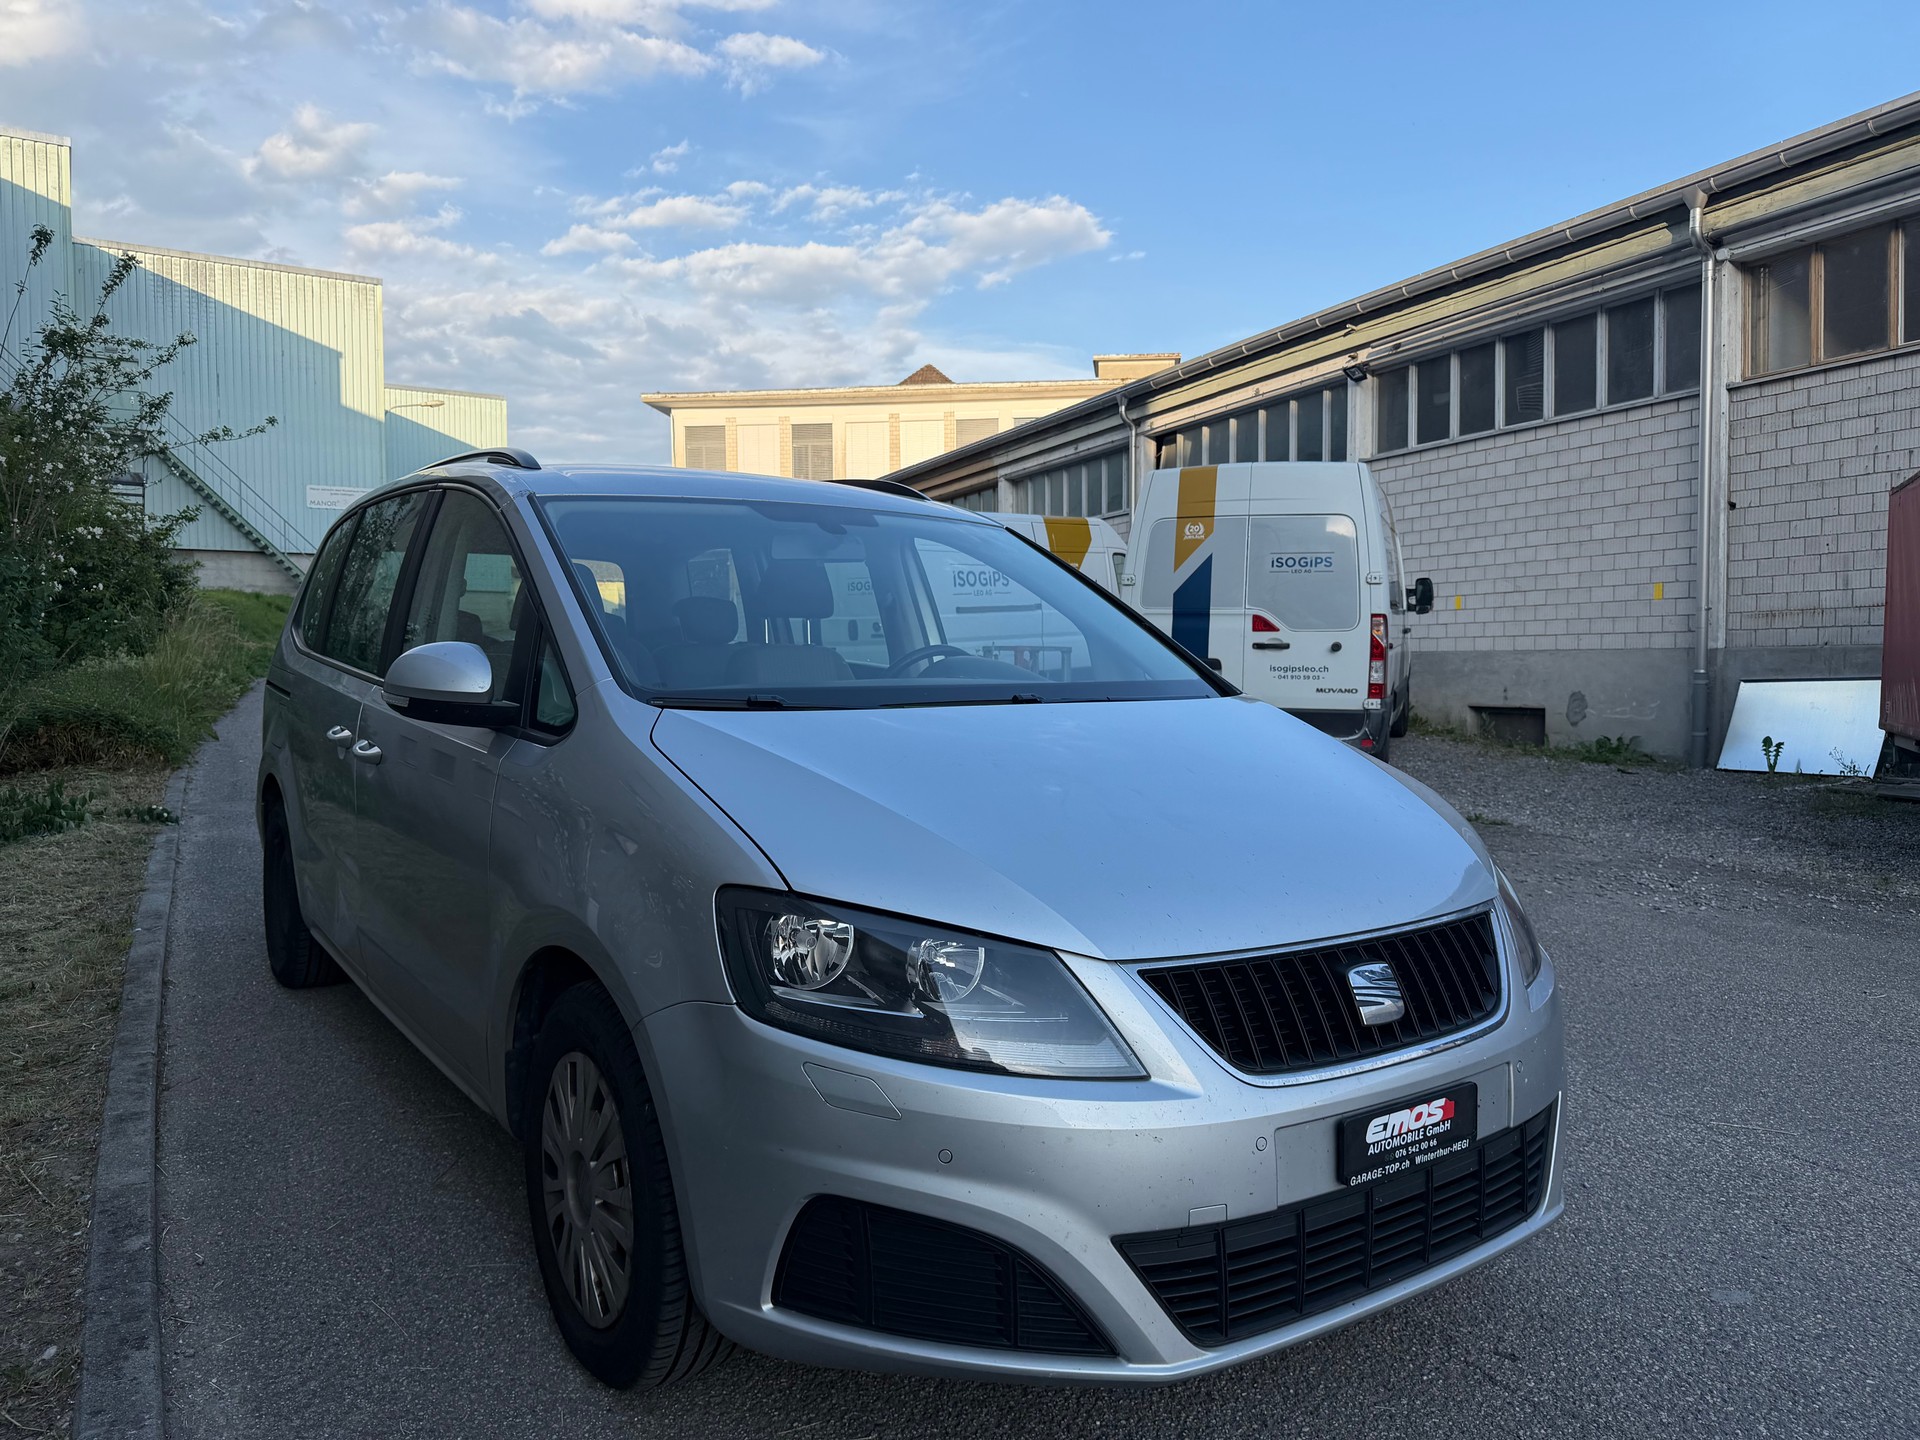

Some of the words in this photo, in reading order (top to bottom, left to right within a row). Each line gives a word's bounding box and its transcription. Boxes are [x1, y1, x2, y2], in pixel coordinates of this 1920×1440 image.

[1269, 665, 1329, 674] isogipsleo.ch
[1367, 1128, 1424, 1156] AUTOMOBILE
[1426, 1120, 1451, 1137] GmbH
[1395, 1147, 1407, 1159] 076
[1408, 1144, 1420, 1155] 542
[1420, 1141, 1429, 1150] 00
[1429, 1138, 1438, 1147] 66
[1350, 1160, 1411, 1186] GARAGE-TOP.ch
[1415, 1139, 1470, 1165] Winterthur-HEGI
